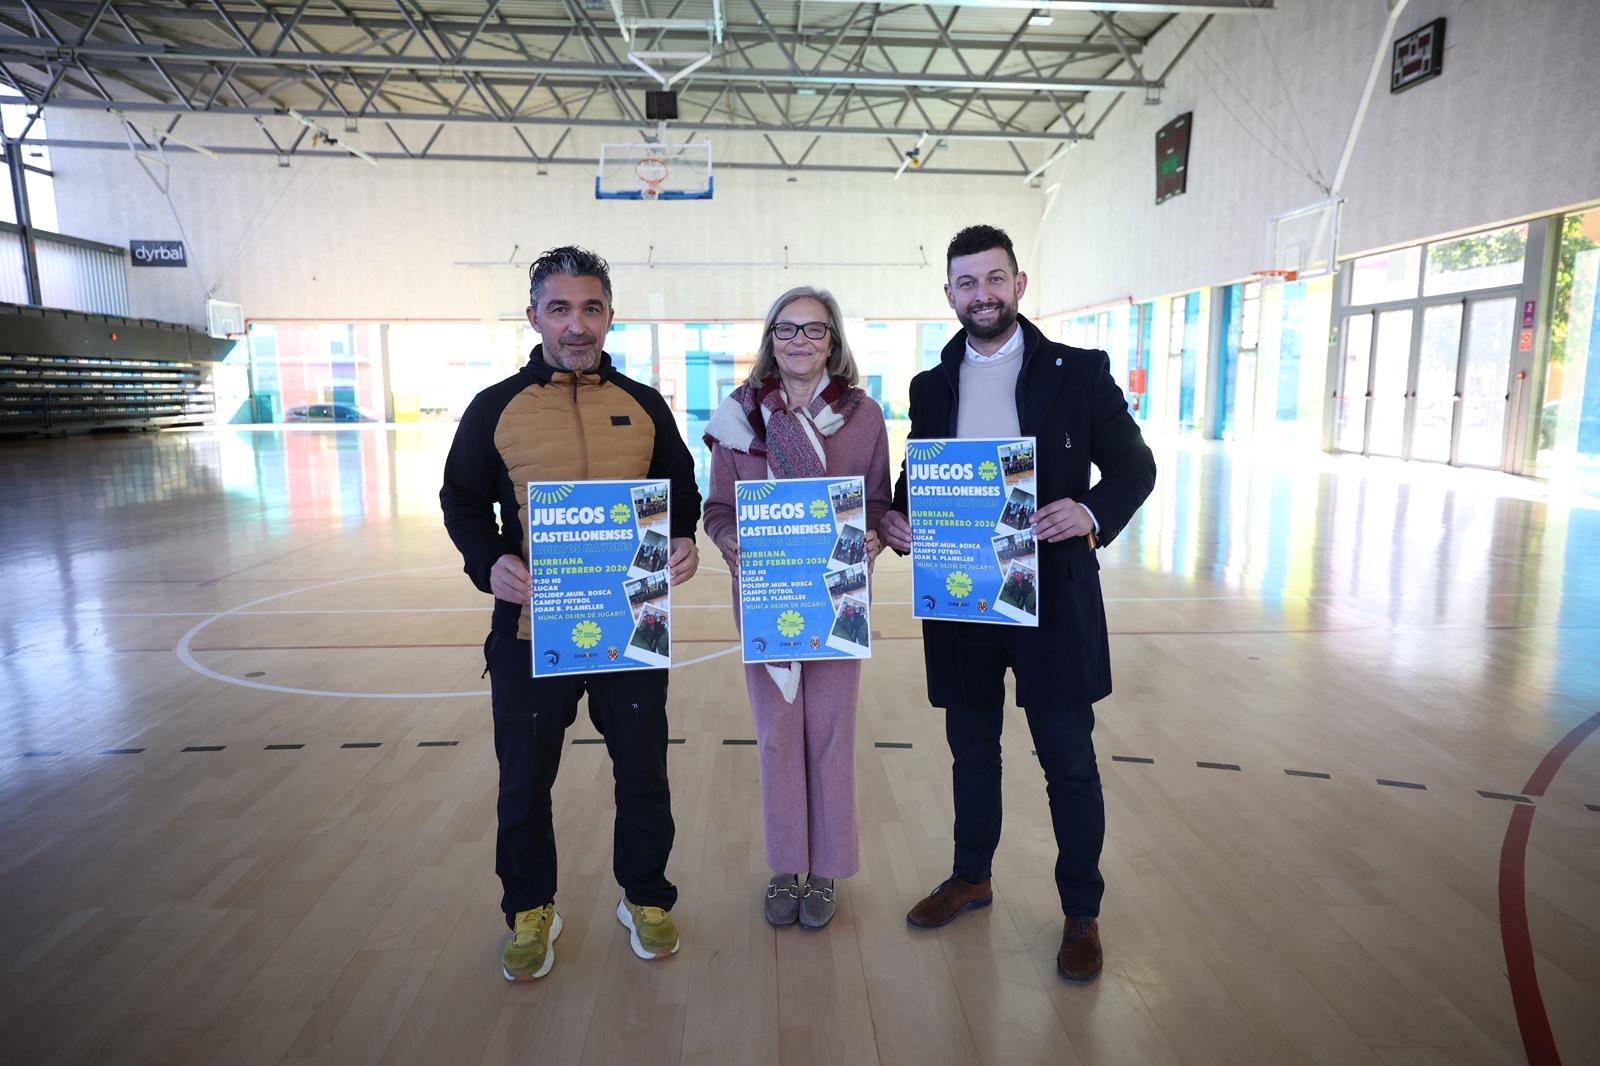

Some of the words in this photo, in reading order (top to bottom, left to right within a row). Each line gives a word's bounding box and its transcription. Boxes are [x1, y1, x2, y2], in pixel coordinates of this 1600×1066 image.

[135, 244, 183, 262] dyrbal
[1527, 302, 1532, 312] 2
[910, 464, 974, 480] JUEGOS
[911, 486, 1000, 496] CASTELLONENSES
[532, 507, 605, 526] JUEGOS
[740, 503, 805, 521] JUEGOS
[532, 529, 633, 543] CASTELLONENSES
[740, 524, 832, 536] CASTELLONENSES
[533, 558, 583, 566] BURRIANA
[561, 566, 602, 574] FEBRERO
